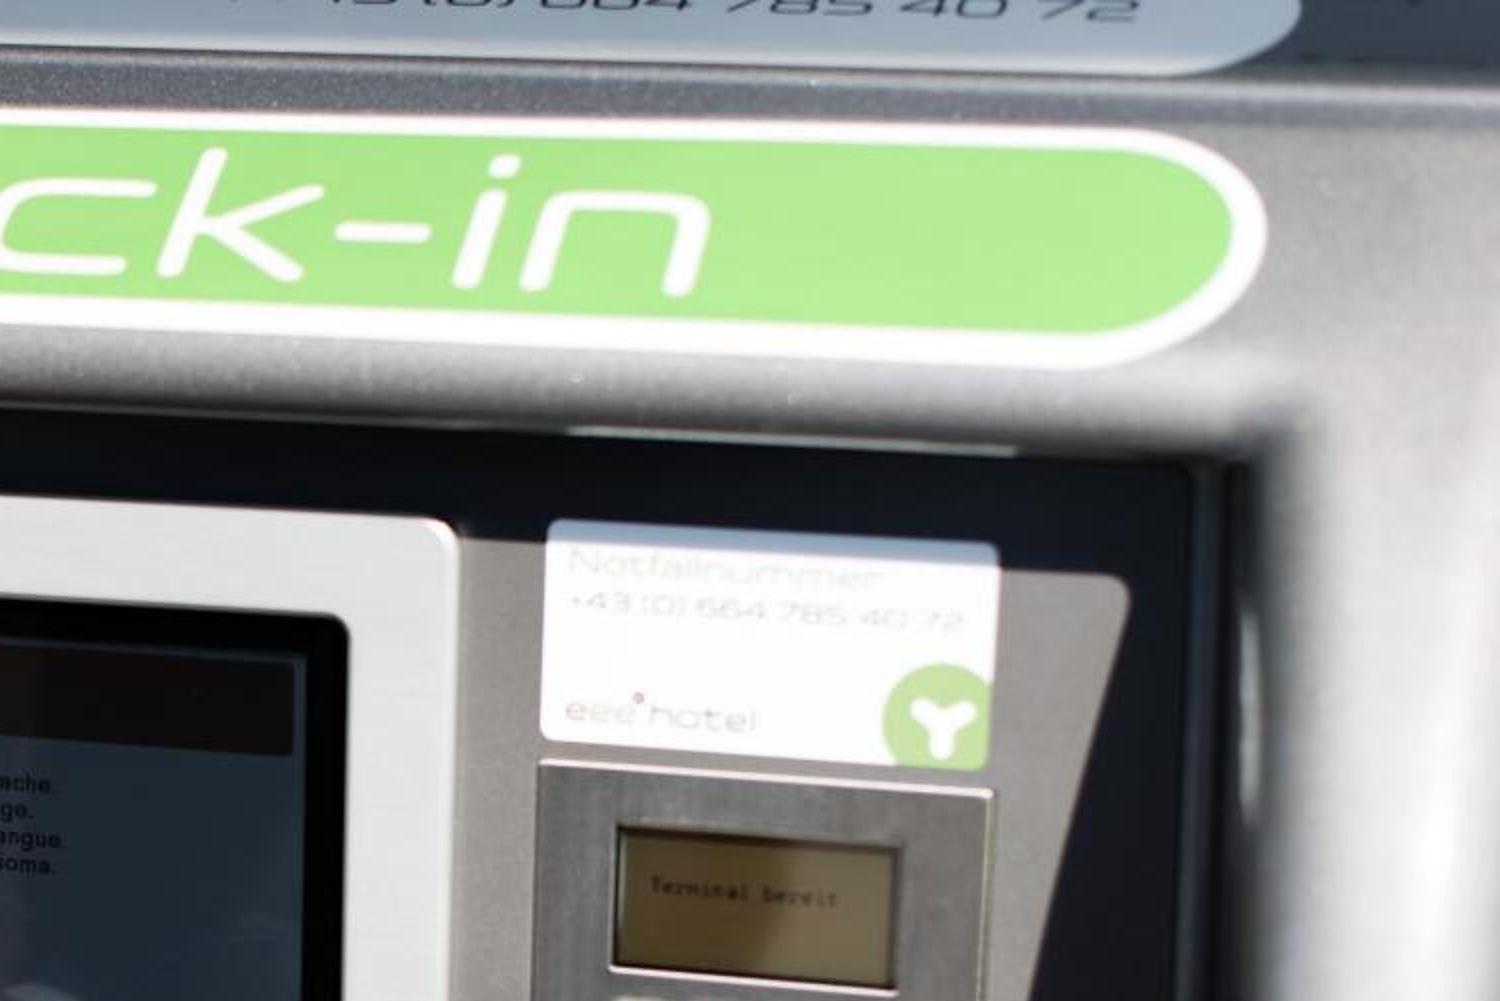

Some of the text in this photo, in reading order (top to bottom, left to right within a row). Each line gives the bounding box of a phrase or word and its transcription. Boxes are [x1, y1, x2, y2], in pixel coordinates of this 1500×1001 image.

[568, 547, 885, 589] Notfallnummer
[695, 596, 767, 620] 664
[781, 601, 849, 625] 785
[858, 607, 909, 630] 40
[921, 611, 965, 634] 72
[649, 701, 758, 734] hotel
[651, 876, 837, 908] Terminal bereit
